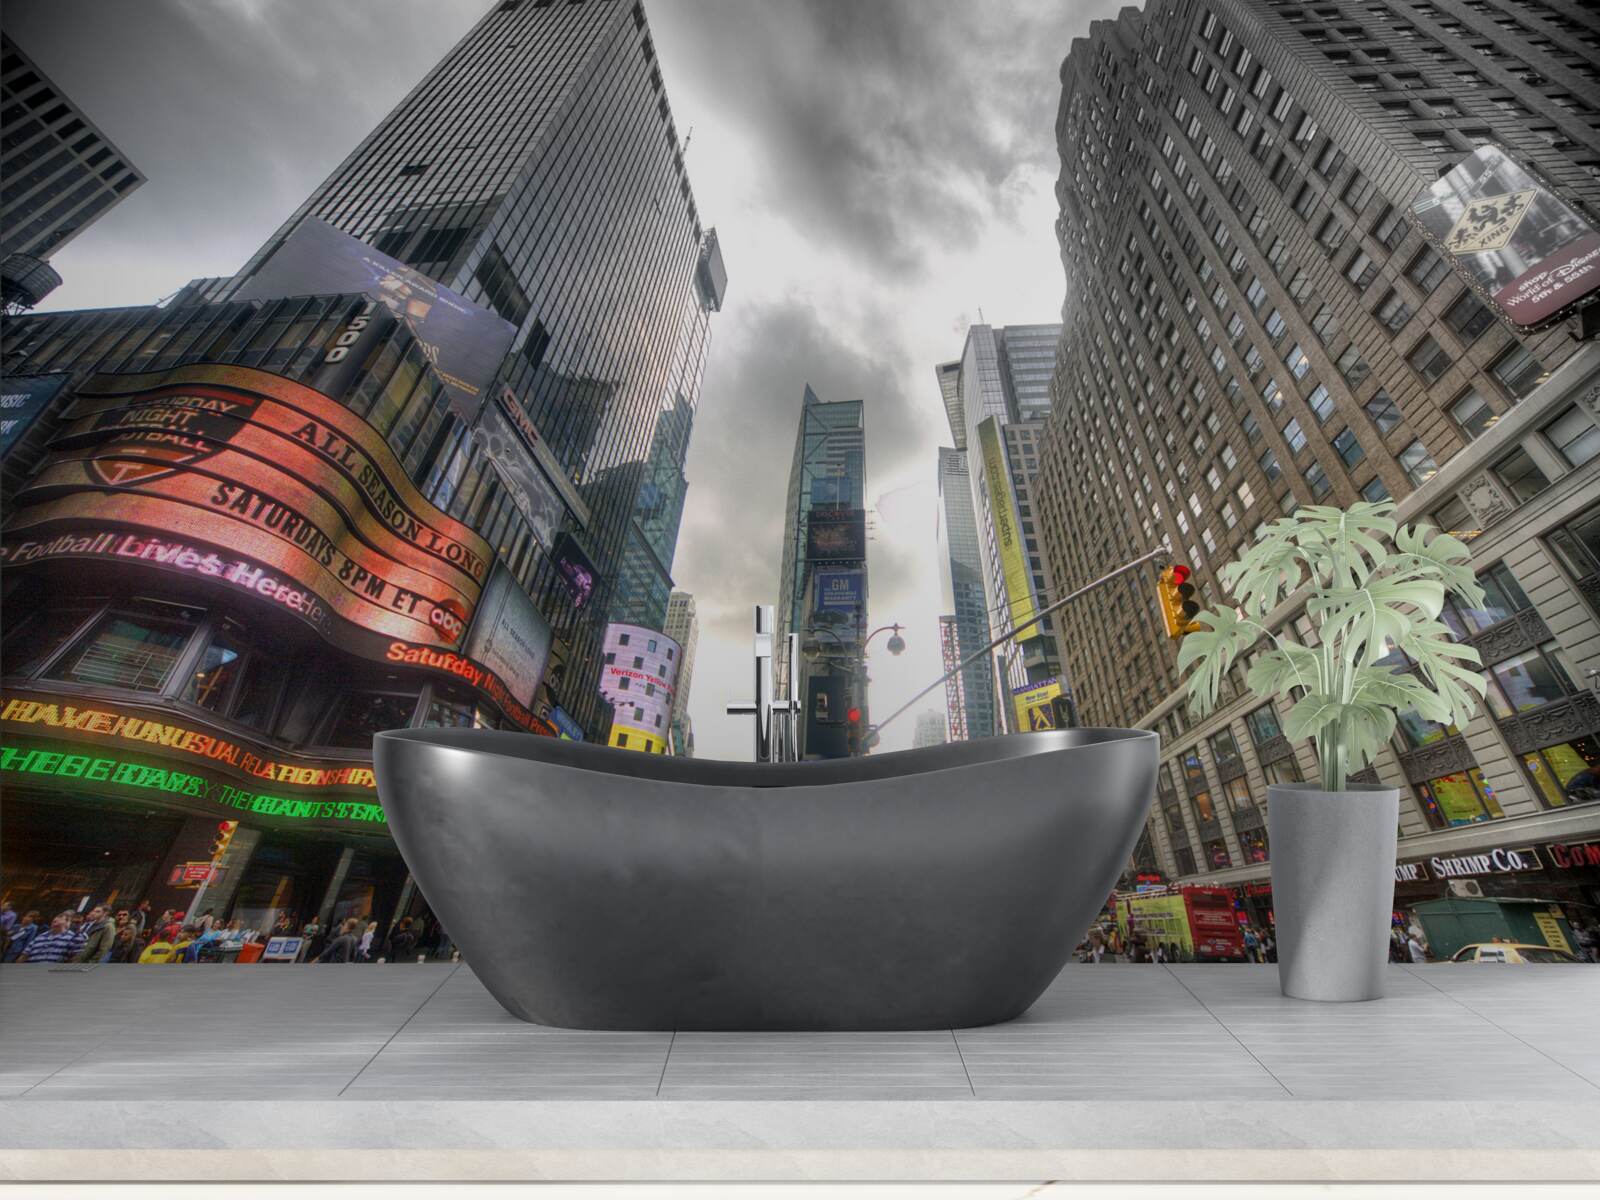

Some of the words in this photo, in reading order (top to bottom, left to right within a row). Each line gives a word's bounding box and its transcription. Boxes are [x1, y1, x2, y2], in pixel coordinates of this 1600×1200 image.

[1478, 224, 1510, 248] XING
[1506, 283, 1541, 306] World
[1518, 271, 1549, 292] shop
[324, 292, 377, 362] 1500
[119, 408, 198, 427] NIGHT
[503, 387, 539, 448] GMC
[293, 421, 357, 469] ALL
[358, 463, 423, 542] SEASON
[425, 531, 486, 579] LONG
[9, 532, 114, 562] Football
[210, 483, 337, 567] SATURDAYS
[338, 560, 387, 600] 8PM
[831, 579, 849, 591] GM
[430, 607, 464, 635] abc
[386, 641, 484, 687] Saturday
[610, 667, 644, 680] Verizon
[1431, 856, 1491, 879] SHRIMP
